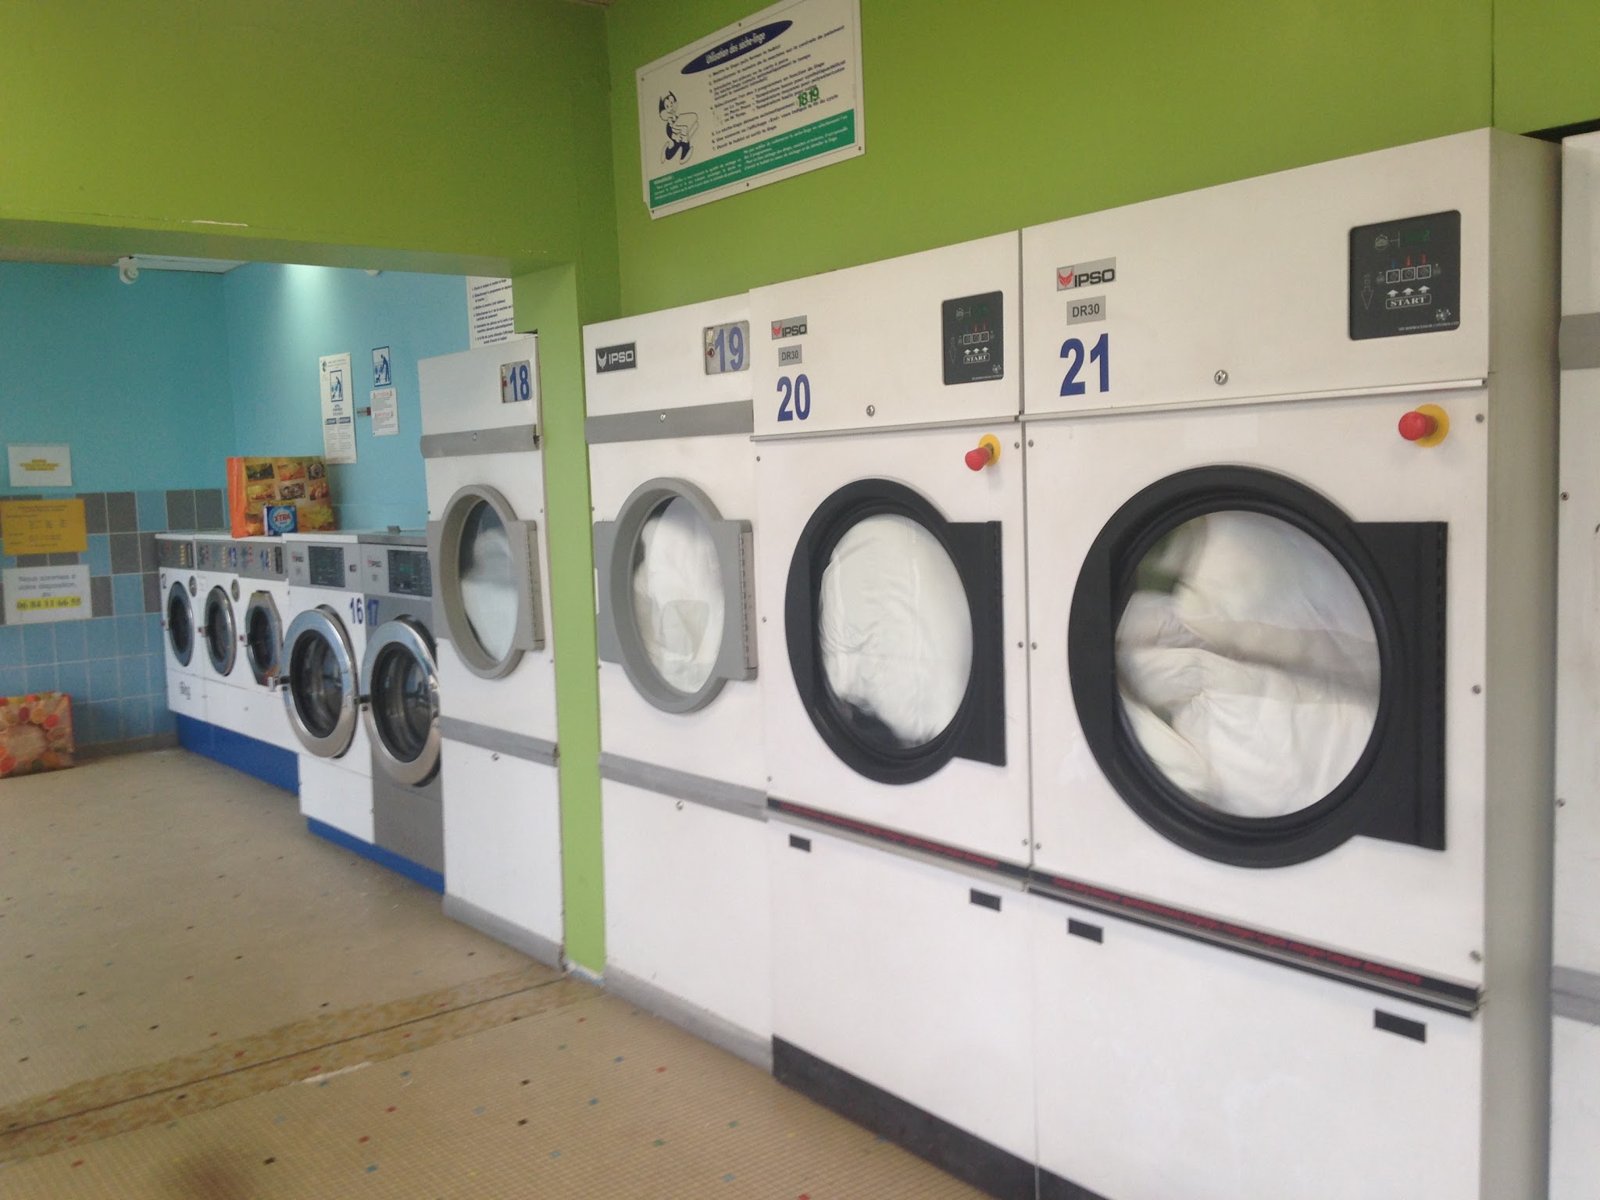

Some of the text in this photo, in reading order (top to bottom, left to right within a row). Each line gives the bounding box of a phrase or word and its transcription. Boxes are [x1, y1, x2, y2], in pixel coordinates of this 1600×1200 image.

[1074, 268, 1115, 287] IPSO
[1071, 302, 1101, 318] DR30
[1390, 295, 1426, 307] START
[782, 323, 807, 337] IPSO
[608, 349, 634, 365] IPSO
[714, 325, 744, 373] 19
[781, 350, 799, 362] DR30
[1060, 332, 1110, 397] 21
[509, 364, 530, 402] 18
[776, 373, 811, 422] 20
[349, 597, 364, 625] 16
[367, 599, 379, 626] 17
